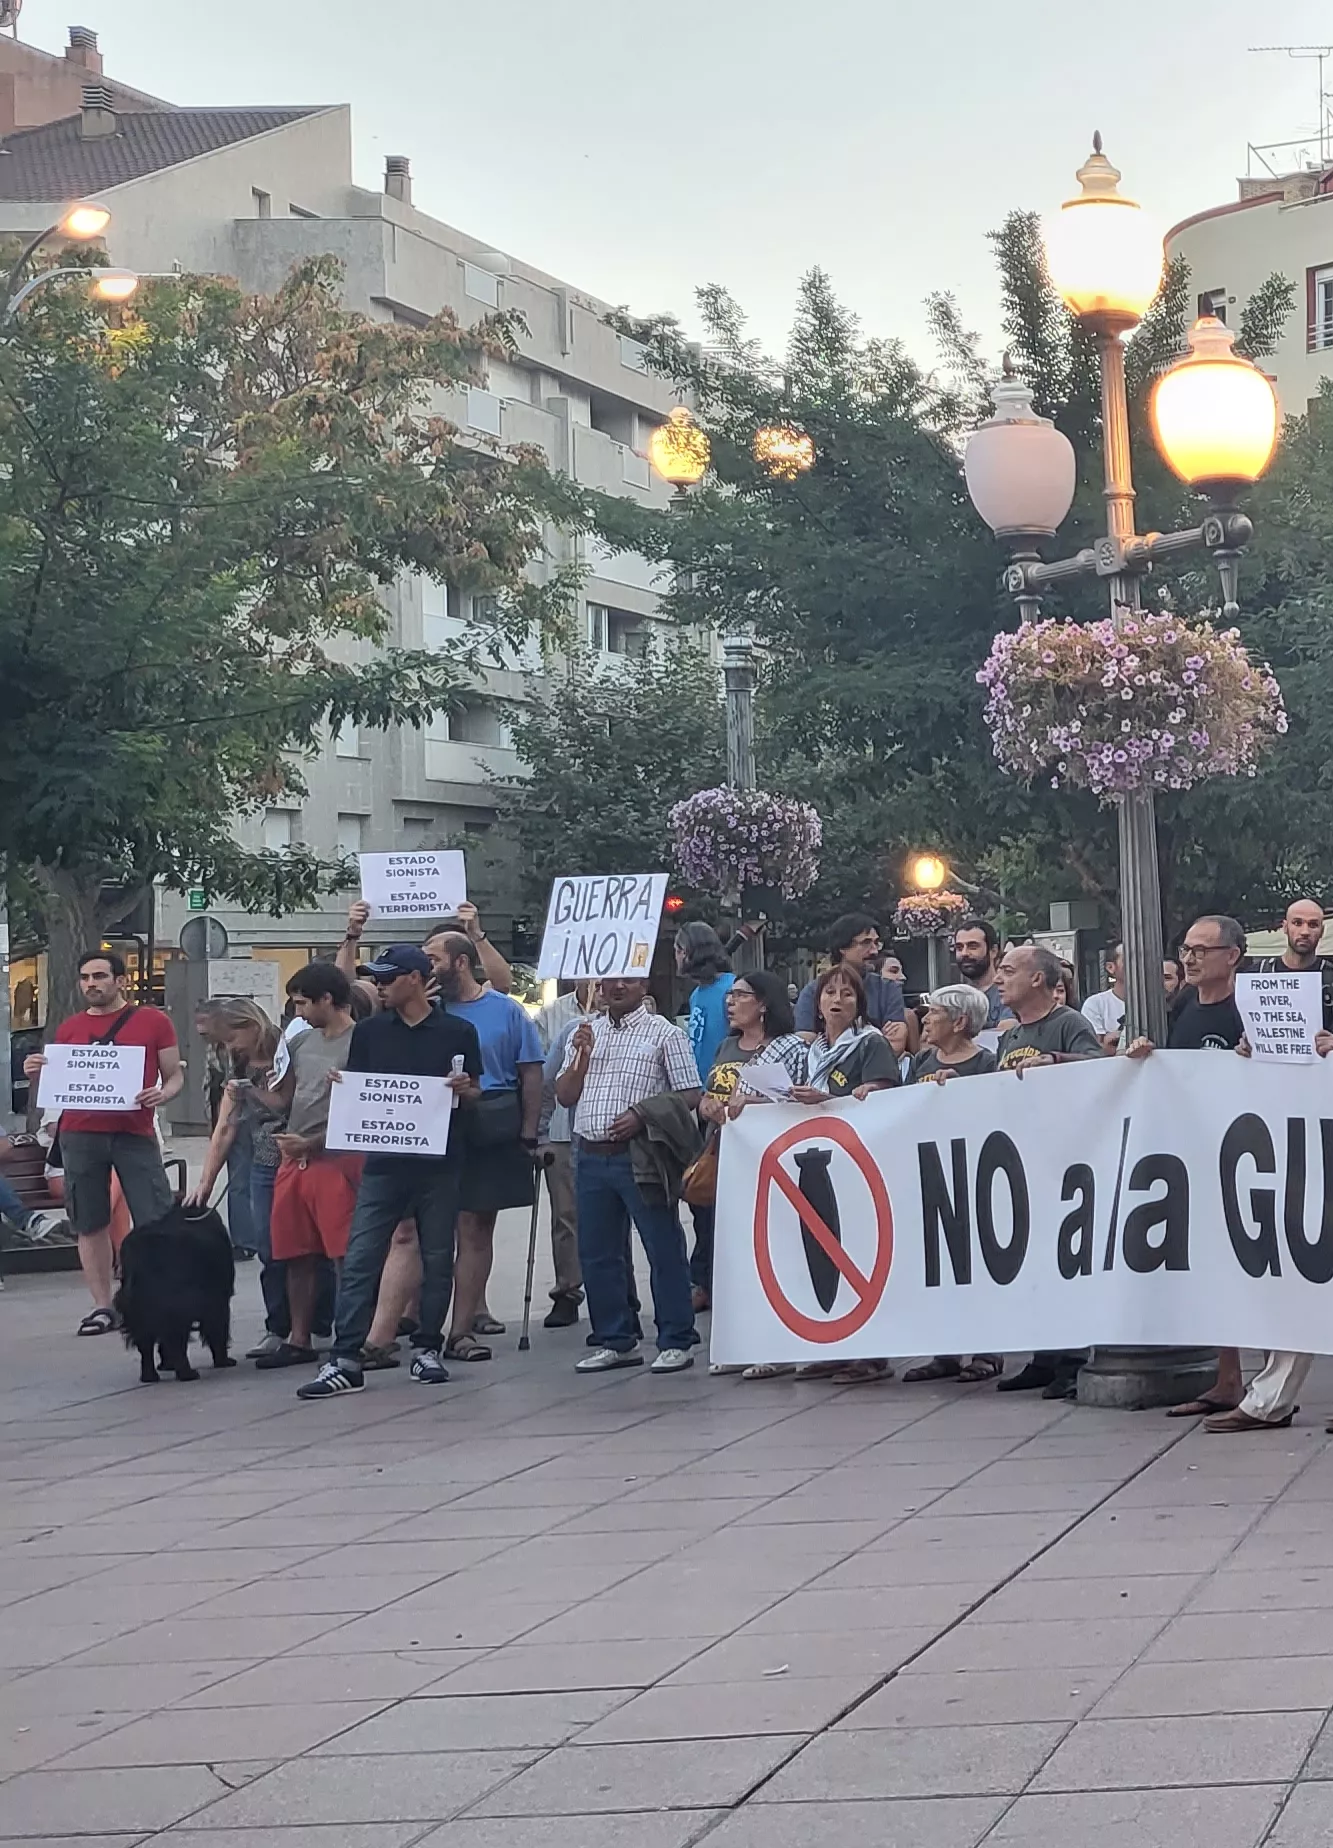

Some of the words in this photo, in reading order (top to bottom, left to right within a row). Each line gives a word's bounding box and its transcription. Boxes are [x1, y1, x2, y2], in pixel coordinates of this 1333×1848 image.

[388, 855, 436, 865] ESTADO
[385, 867, 440, 878] SIONISTA
[390, 891, 437, 901] ESTADO
[554, 876, 653, 925] GUERRA
[378, 903, 451, 914] TERRORISTA
[1250, 979, 1278, 990] FROM
[1280, 979, 1300, 989] THE
[1260, 995, 1292, 1008] RIVER,
[1248, 1011, 1261, 1022] TO
[1263, 1011, 1284, 1022] THE
[1285, 1012, 1307, 1024] SEA,
[1256, 1027, 1306, 1039] PALESTINE
[72, 1049, 118, 1058] ESTADO
[1254, 1042, 1275, 1054] WILL
[1276, 1043, 1289, 1054] BE
[1290, 1044, 1313, 1055] FREE
[67, 1060, 120, 1070] SIONISTA
[68, 1083, 114, 1092] ESTADO
[365, 1078, 420, 1090] ESTADO
[54, 1094, 126, 1104] TERRORISTA
[359, 1092, 422, 1104] SIONISTA
[361, 1120, 416, 1131] ESTADO
[345, 1132, 429, 1147] TERRORISTA
[917, 1130, 1030, 1287] NO
